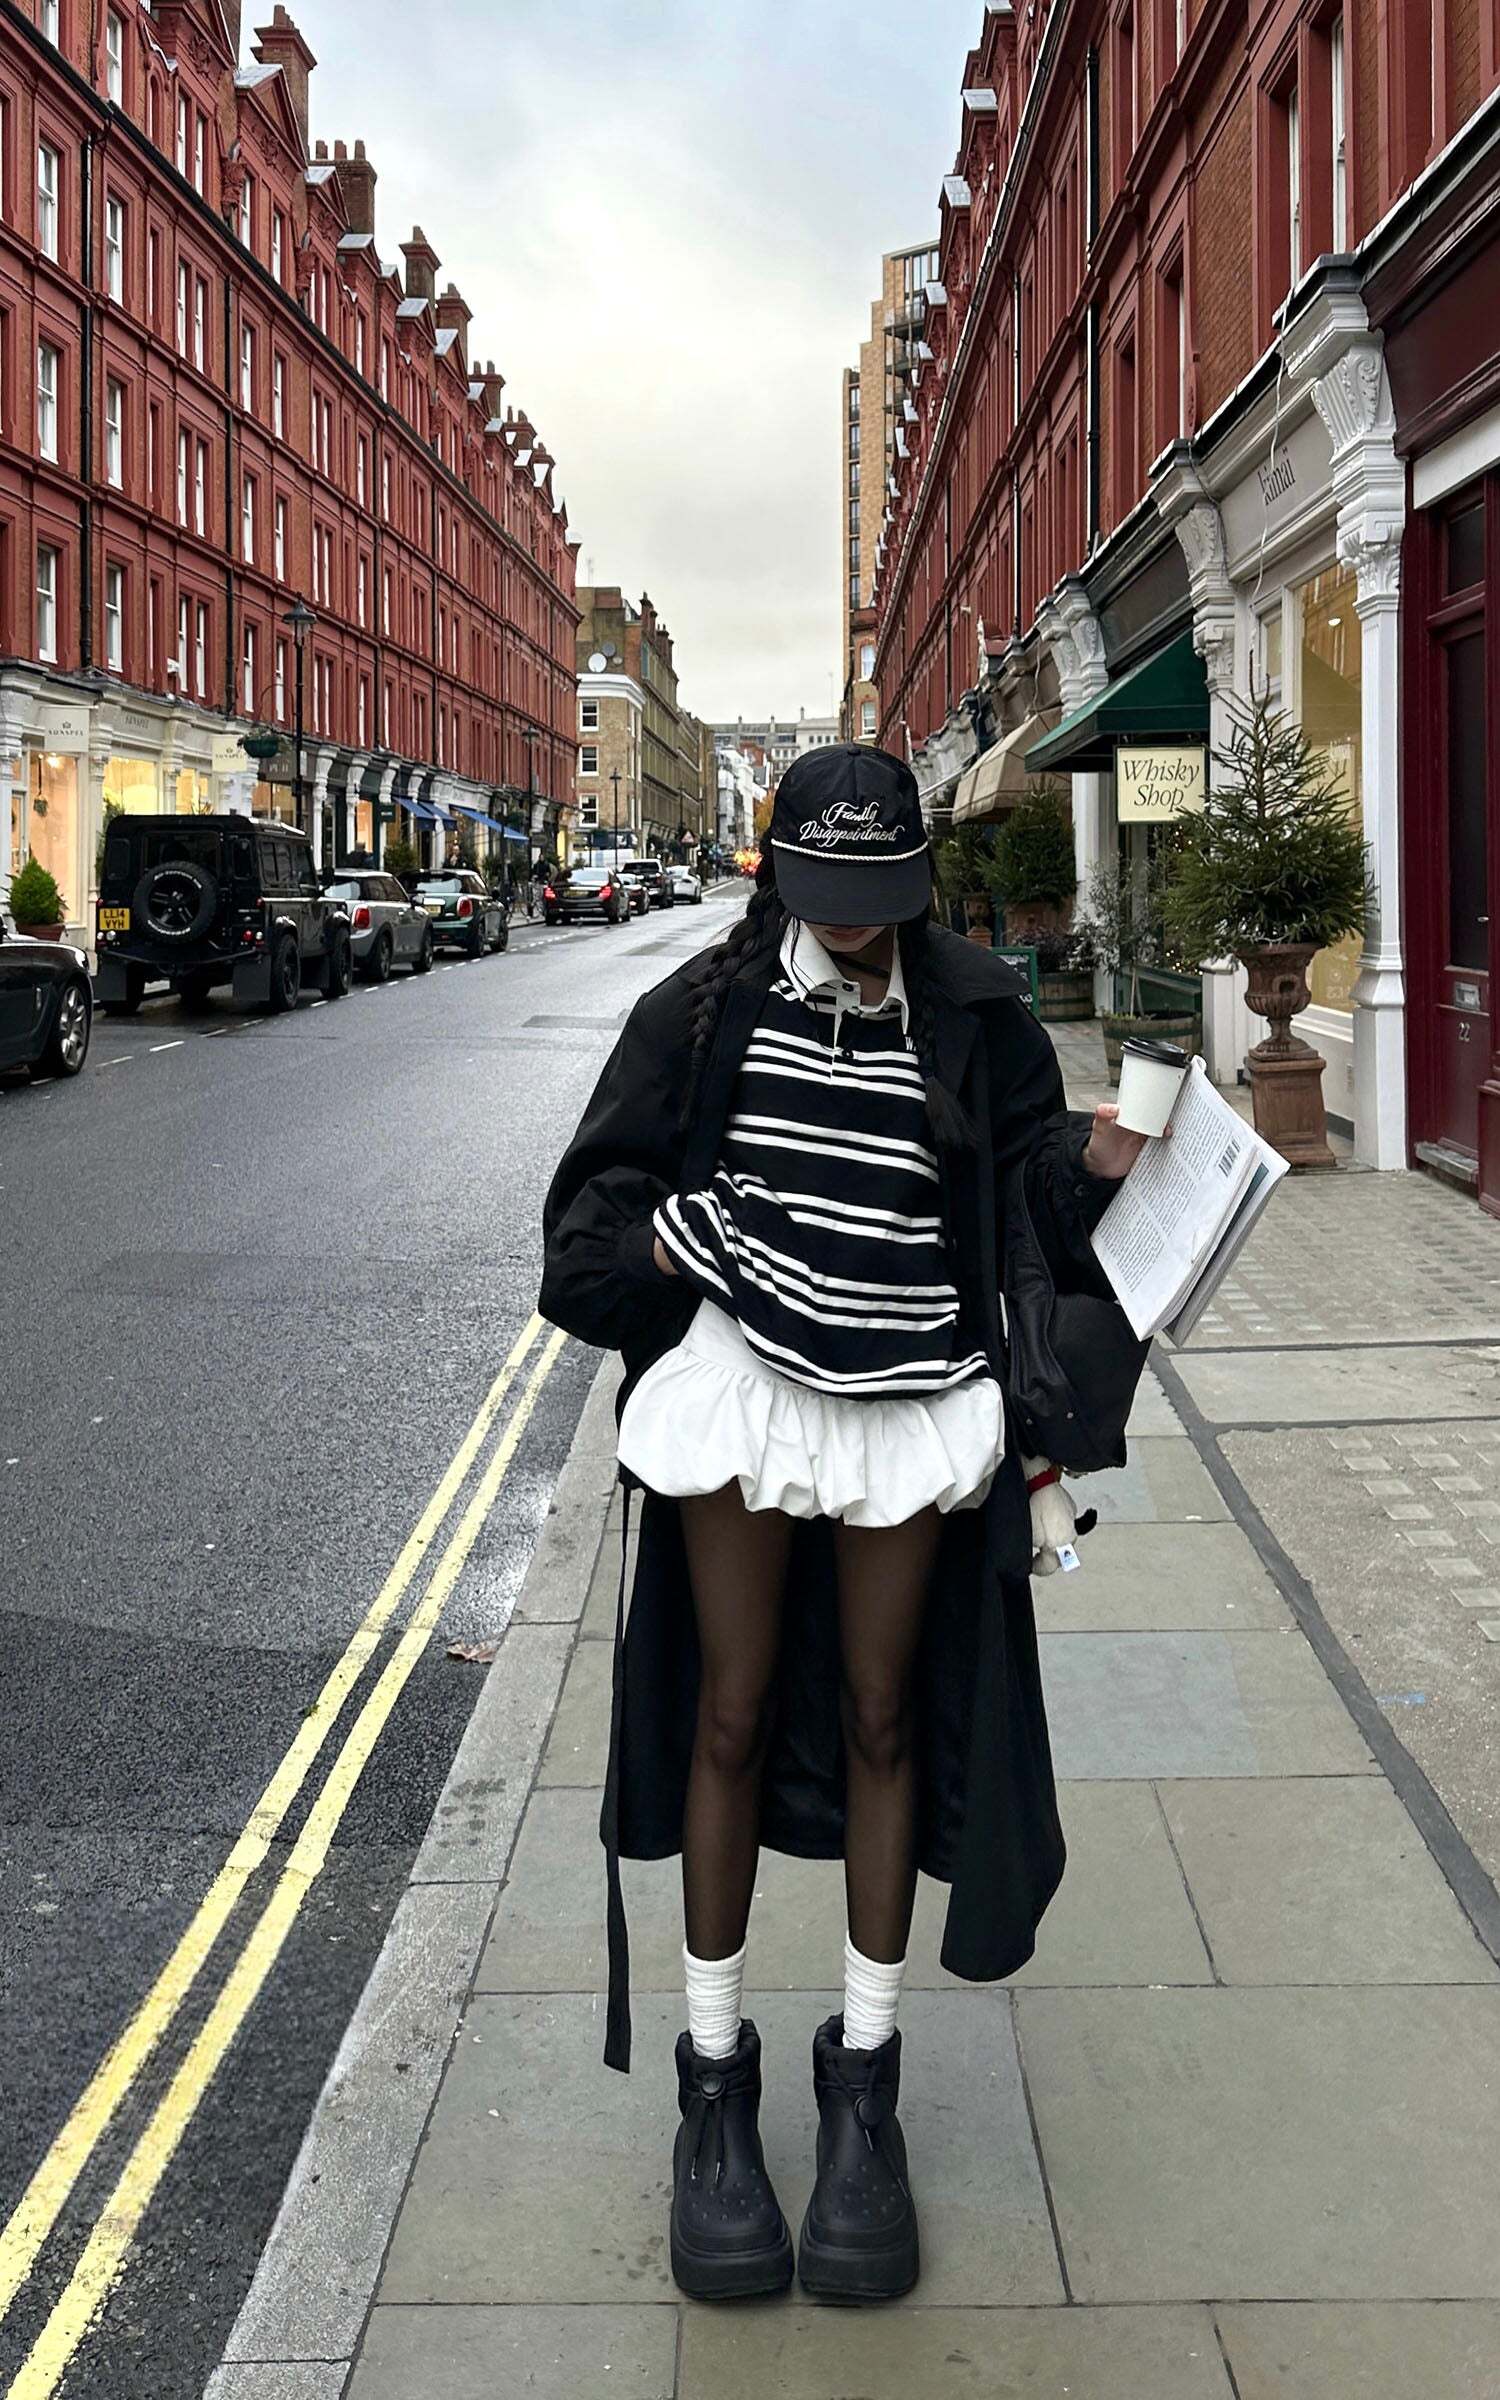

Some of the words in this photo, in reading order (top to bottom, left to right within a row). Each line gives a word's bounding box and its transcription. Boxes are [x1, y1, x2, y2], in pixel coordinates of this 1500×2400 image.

[1123, 758, 1200, 788] Whisky
[1134, 784, 1185, 812] Shop
[822, 802, 880, 828] Family
[800, 820, 906, 847] Disappointment
[1458, 1022, 1471, 1042] 22
